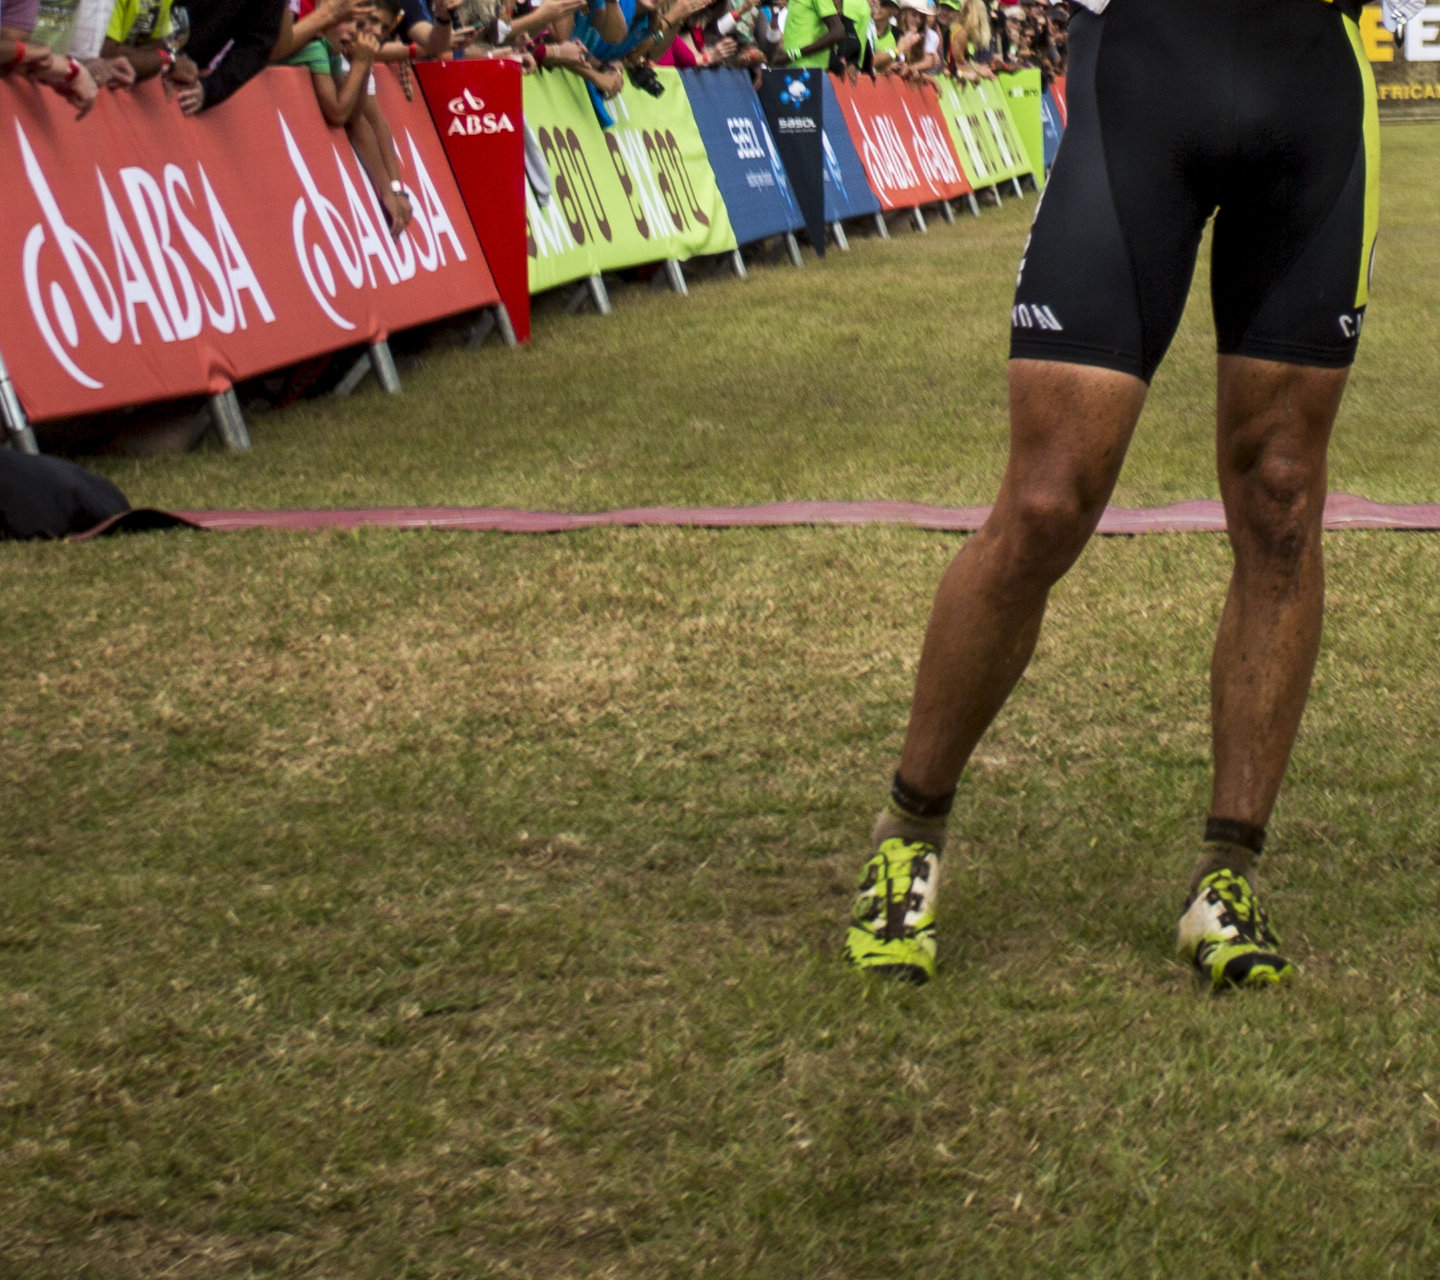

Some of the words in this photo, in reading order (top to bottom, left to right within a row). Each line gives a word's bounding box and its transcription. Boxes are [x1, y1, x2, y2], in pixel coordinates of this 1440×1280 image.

[447, 112, 516, 137] ABSA
[604, 127, 710, 241] exxaro
[95, 159, 276, 346] ABSA
